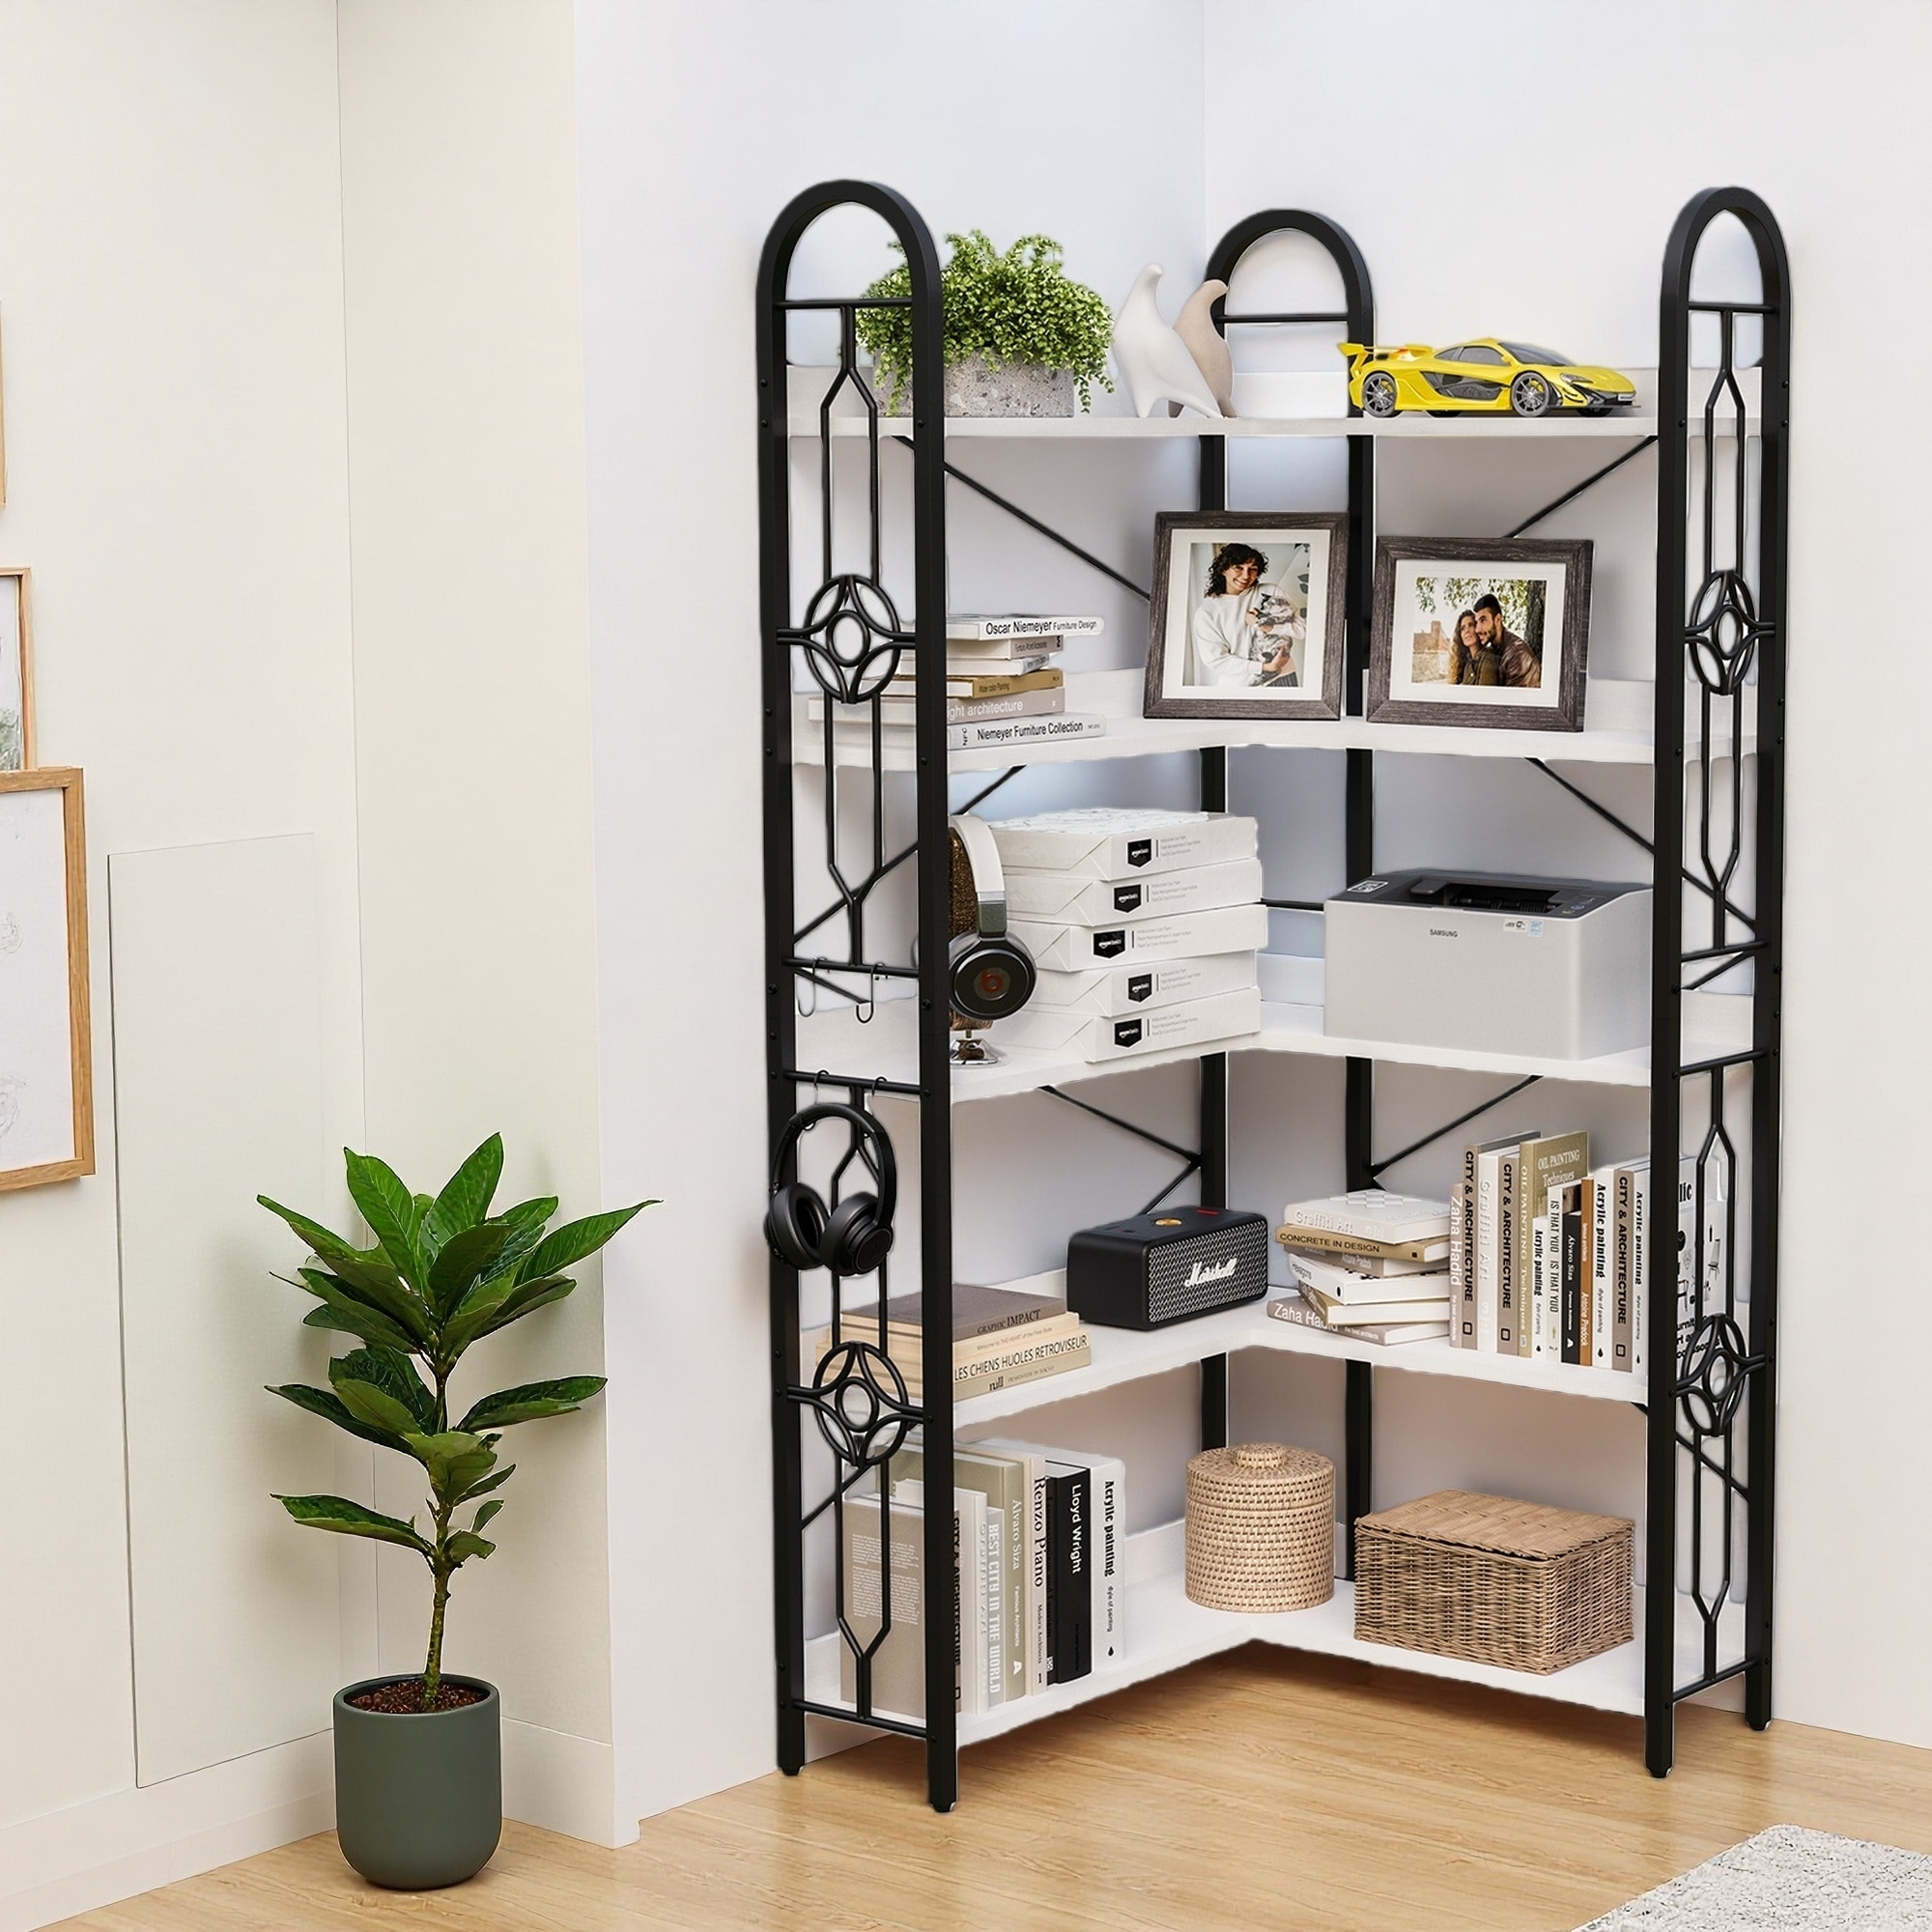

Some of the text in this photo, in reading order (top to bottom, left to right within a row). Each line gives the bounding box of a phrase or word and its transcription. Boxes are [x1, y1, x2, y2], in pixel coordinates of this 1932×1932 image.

[985, 620, 1097, 635] Oscar Niemeyer Furniture Design
[967, 701, 1024, 717] architecture
[978, 727, 1012, 741] Niemeyer
[1014, 723, 1047, 738] Furniture
[1047, 721, 1084, 735] Collection
[1538, 1150, 1580, 1171] OIL PAINTING
[1543, 1171, 1575, 1187] Techniques
[1550, 1201, 1559, 1209] IS
[1634, 1192, 1643, 1233] Acrylic
[1464, 1151, 1474, 1302] CITY & ARCHITECTURE
[1480, 1179, 1492, 1281] Graffiti Art
[1550, 1211, 1559, 1233] THAT
[1596, 1184, 1605, 1278] Acrylic painting
[1279, 1233, 1331, 1246] CONCRETE
[1345, 1242, 1379, 1252] DESIGN
[1451, 1196, 1463, 1286] Zaha Hadid
[1502, 1163, 1513, 1309] CITY & ARCHITECTURE
[1534, 1229, 1544, 1296] Acrylic painting
[1617, 1177, 1628, 1324] CITY & ARCHITECTURE
[1549, 1260, 1559, 1269] IS
[1549, 1271, 1559, 1293] THAT
[1275, 1302, 1302, 1323] Zaha
[1580, 1293, 1589, 1318] Antoine
[978, 1309, 1041, 1335] GRAPHIC IMPACT
[954, 1334, 1088, 1381] LES CHIENS HUOLES RETROVISEUR
[1034, 1477, 1046, 1588] Renzo Piano
[1070, 1484, 1082, 1575] Lloyd Wright
[1104, 1480, 1115, 1577] Acrylic painting
[1012, 1544, 1022, 1571] Siza
[988, 1523, 1002, 1693] BEST CITY IN THE WORLD
